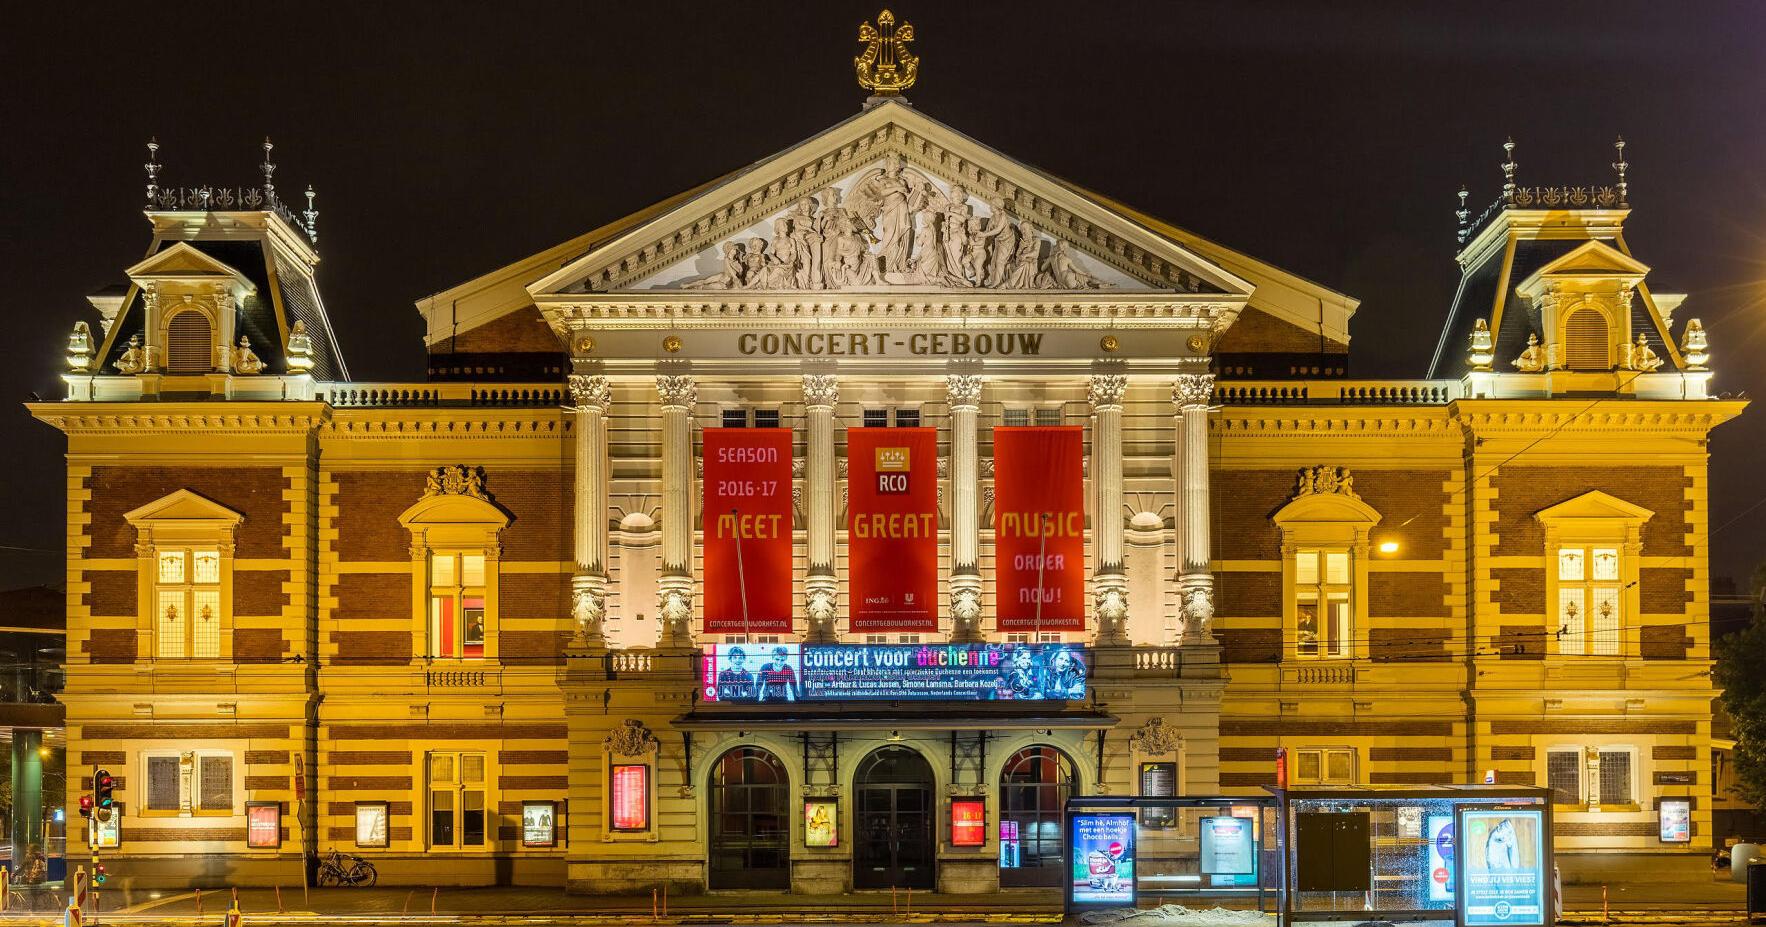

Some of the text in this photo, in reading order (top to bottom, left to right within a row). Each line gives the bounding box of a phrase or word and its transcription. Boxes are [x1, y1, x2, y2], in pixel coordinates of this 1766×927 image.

[718, 447, 778, 463] SEASON
[879, 475, 907, 492] RCO
[717, 513, 783, 540] MEET
[854, 513, 932, 539] GREAT
[1001, 511, 1080, 538] MUSIC
[1014, 554, 1065, 571] ORDER
[709, 620, 788, 628] CONCERTGEBUWORKEST.NL
[804, 645, 998, 667] concert voor duchenne
[831, 680, 852, 688] Arthur
[858, 680, 877, 688] Lucas
[902, 680, 925, 688] Simone
[954, 680, 979, 688] Barbara
